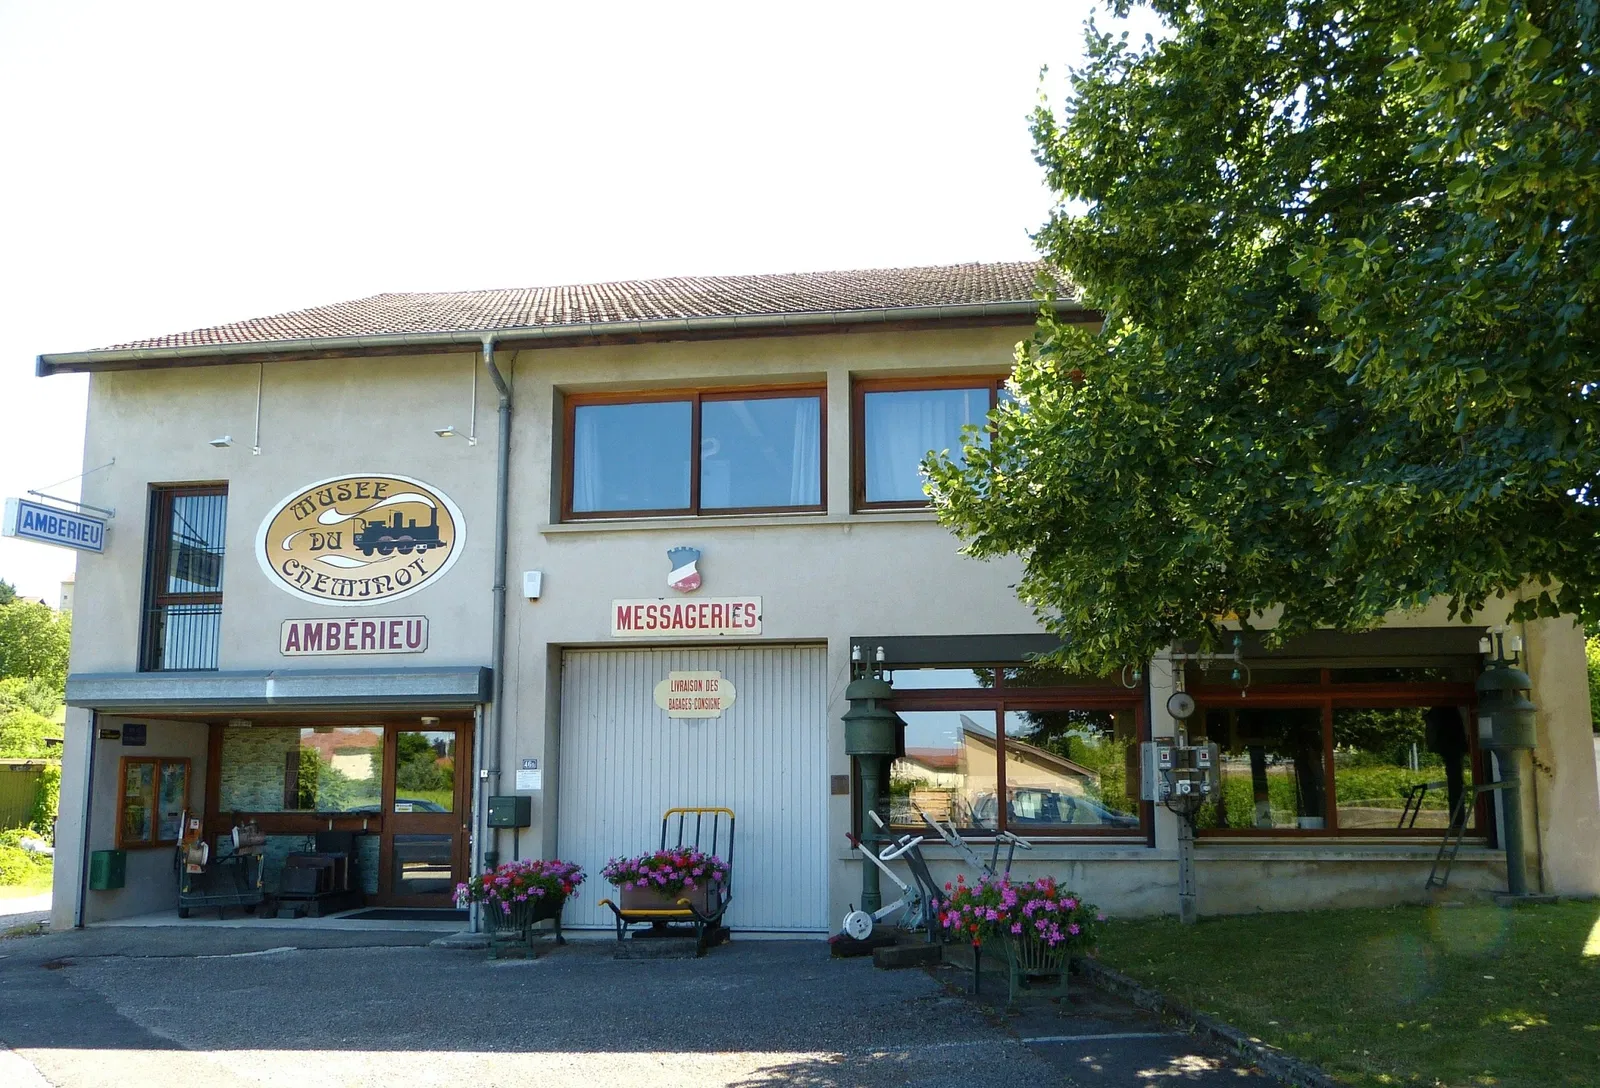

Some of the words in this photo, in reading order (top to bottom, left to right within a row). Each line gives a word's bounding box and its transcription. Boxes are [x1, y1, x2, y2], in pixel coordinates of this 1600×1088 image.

[290, 482, 389, 520] MUSEE
[23, 511, 99, 544] AMBERIEU
[309, 532, 342, 551] DU
[282, 558, 429, 597] CHEMINOT
[617, 603, 756, 630] MESSAGERIES
[285, 619, 421, 652] AMBÉRIEU
[671, 679, 702, 692] LIVRAISON
[705, 679, 719, 692] DES
